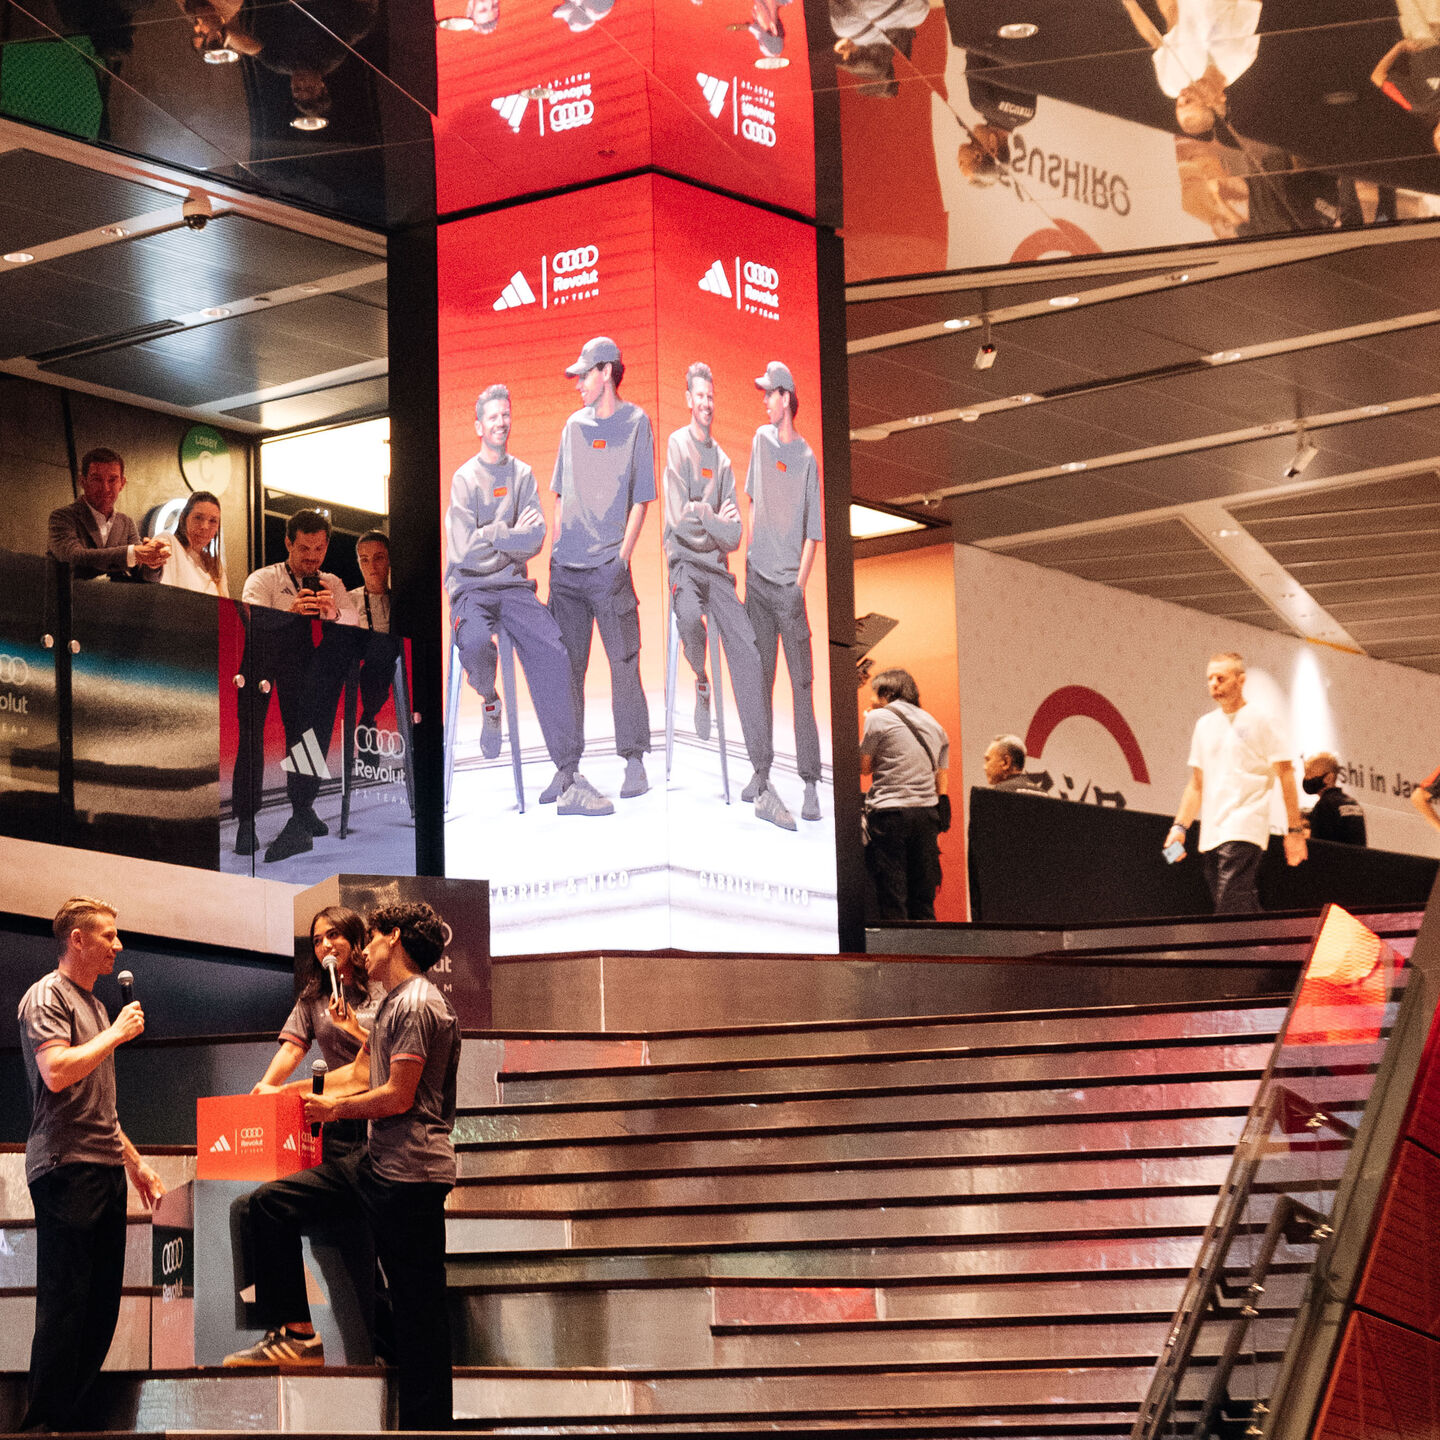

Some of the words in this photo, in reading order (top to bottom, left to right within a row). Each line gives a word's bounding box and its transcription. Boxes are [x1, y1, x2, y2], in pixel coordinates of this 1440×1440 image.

[195, 435, 218, 449] LOBBY
[355, 759, 406, 786] Revolut
[1369, 766, 1387, 794] in
[585, 869, 631, 893] NICO
[699, 870, 757, 898] GABRIEL
[777, 887, 810, 907] NICO
